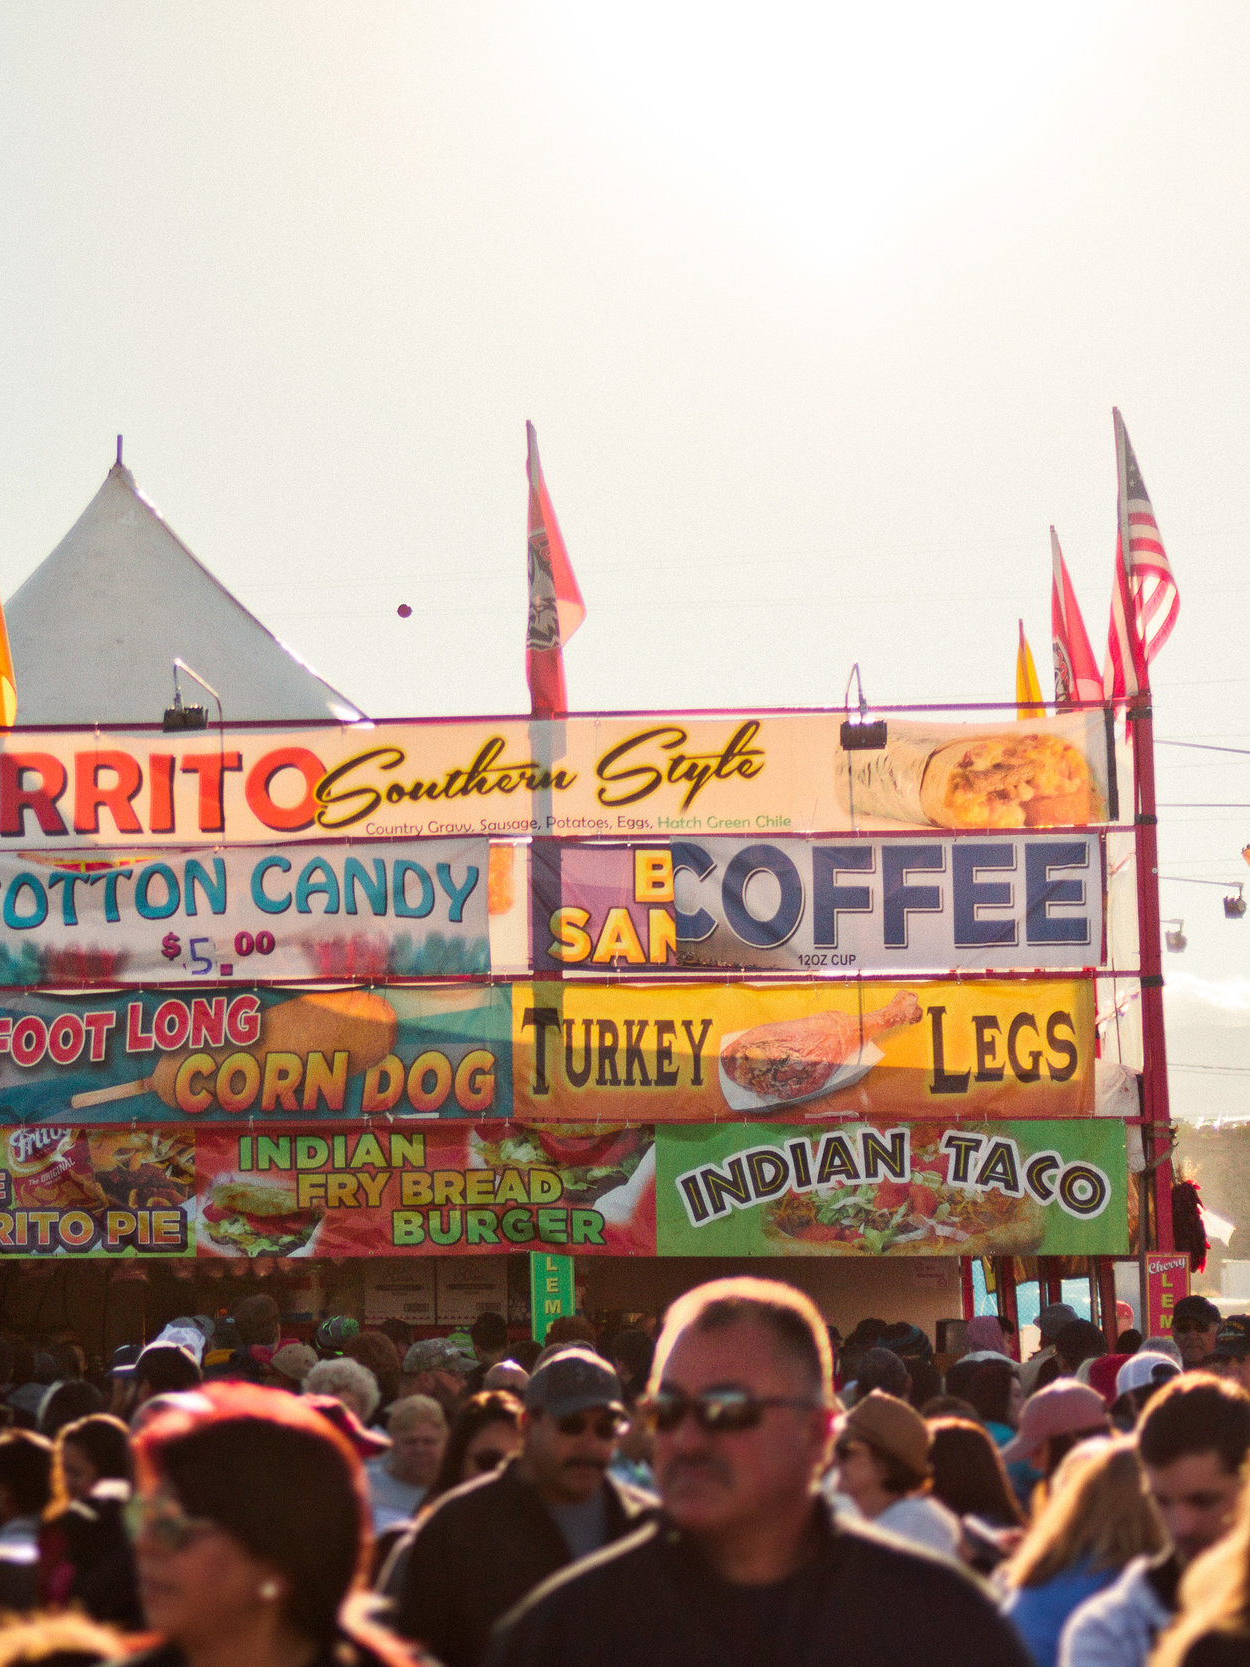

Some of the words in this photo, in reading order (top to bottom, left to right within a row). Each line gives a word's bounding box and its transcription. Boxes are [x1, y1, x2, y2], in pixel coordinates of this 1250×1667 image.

[314, 737, 577, 829] Southern
[595, 720, 766, 815] Style
[365, 821, 421, 837] Country
[480, 817, 541, 833] Sausage,
[546, 814, 612, 831] Potatoes,
[617, 815, 653, 831] Eggs,
[657, 815, 701, 830] Hatch
[706, 815, 750, 829] Green
[755, 814, 792, 828] Chile
[251, 854, 480, 923] CANDY
[670, 840, 1091, 949] COFFEE
[831, 954, 857, 966] CUP
[125, 994, 261, 1053] LONG
[521, 1005, 712, 1095] TURKEY
[927, 1005, 1080, 1094] LEGS
[173, 1050, 350, 1114] CORN
[361, 1049, 497, 1113] DOG
[40, 1157, 76, 1183] ORIGINAL
[238, 1133, 426, 1171] INDIAN
[677, 1128, 910, 1224] INDIAN
[944, 1131, 1108, 1216] TACO
[297, 1173, 394, 1209] FRY
[400, 1168, 564, 1207] BREAD
[106, 1208, 183, 1247] PIE
[391, 1208, 607, 1247] BURGER
[1148, 1258, 1185, 1275] Cherry
[544, 1256, 562, 1334] LEM
